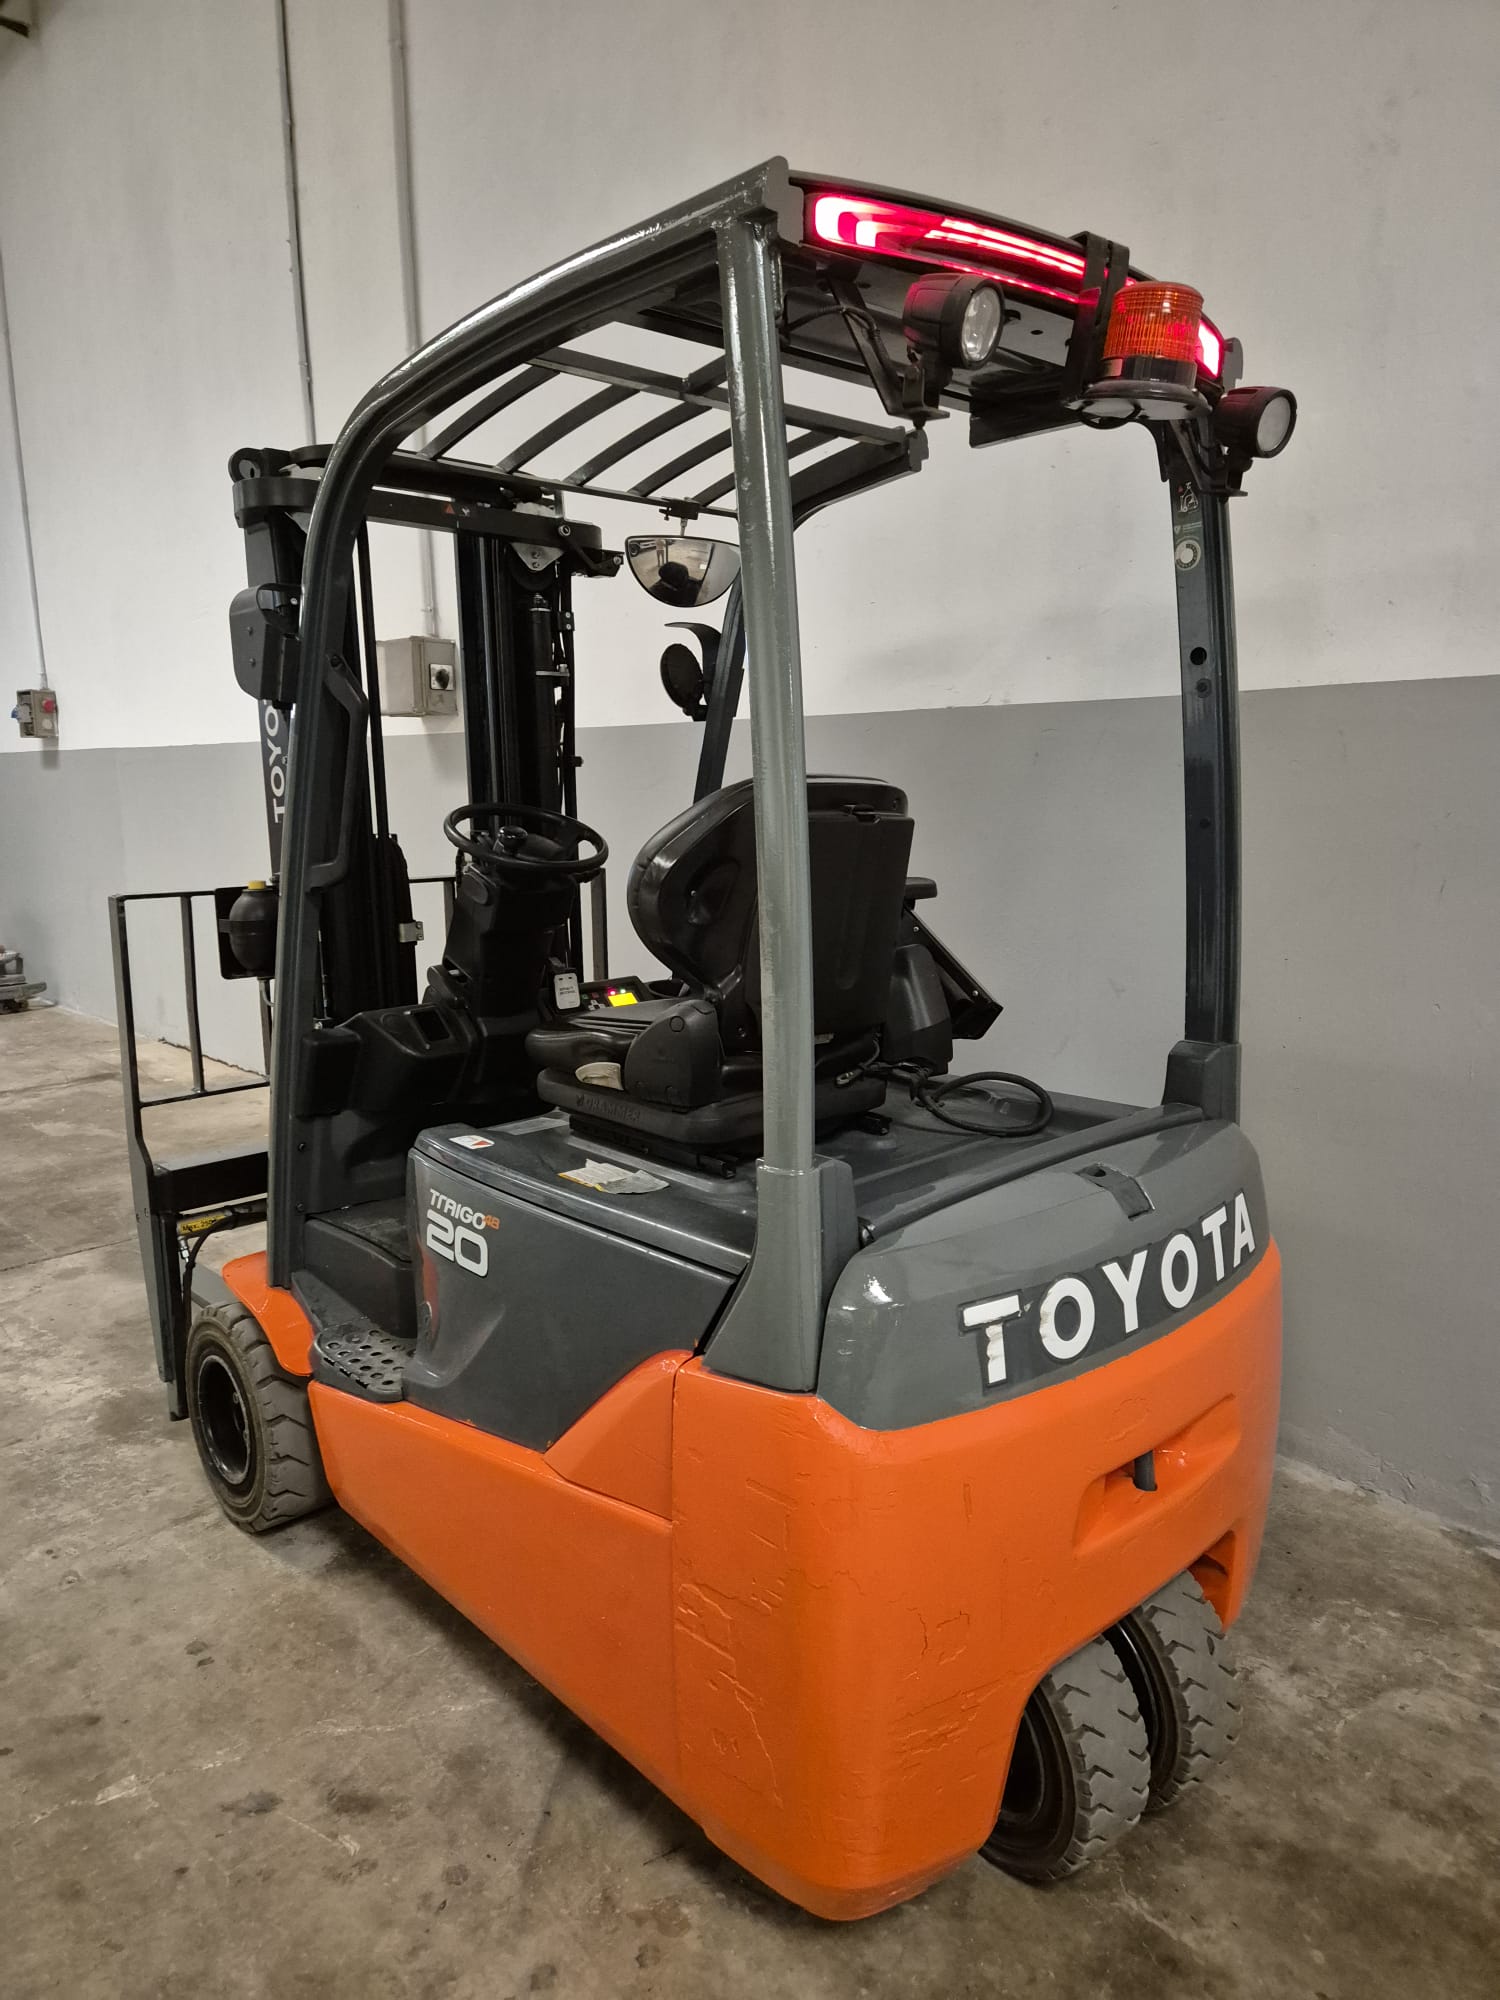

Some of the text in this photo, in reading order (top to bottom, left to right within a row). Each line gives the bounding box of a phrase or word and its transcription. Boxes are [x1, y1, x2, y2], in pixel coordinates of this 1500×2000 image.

[256, 699, 286, 823] TOYO
[427, 1209, 488, 1277] 20
[963, 1192, 1256, 1384] TOYOTA
